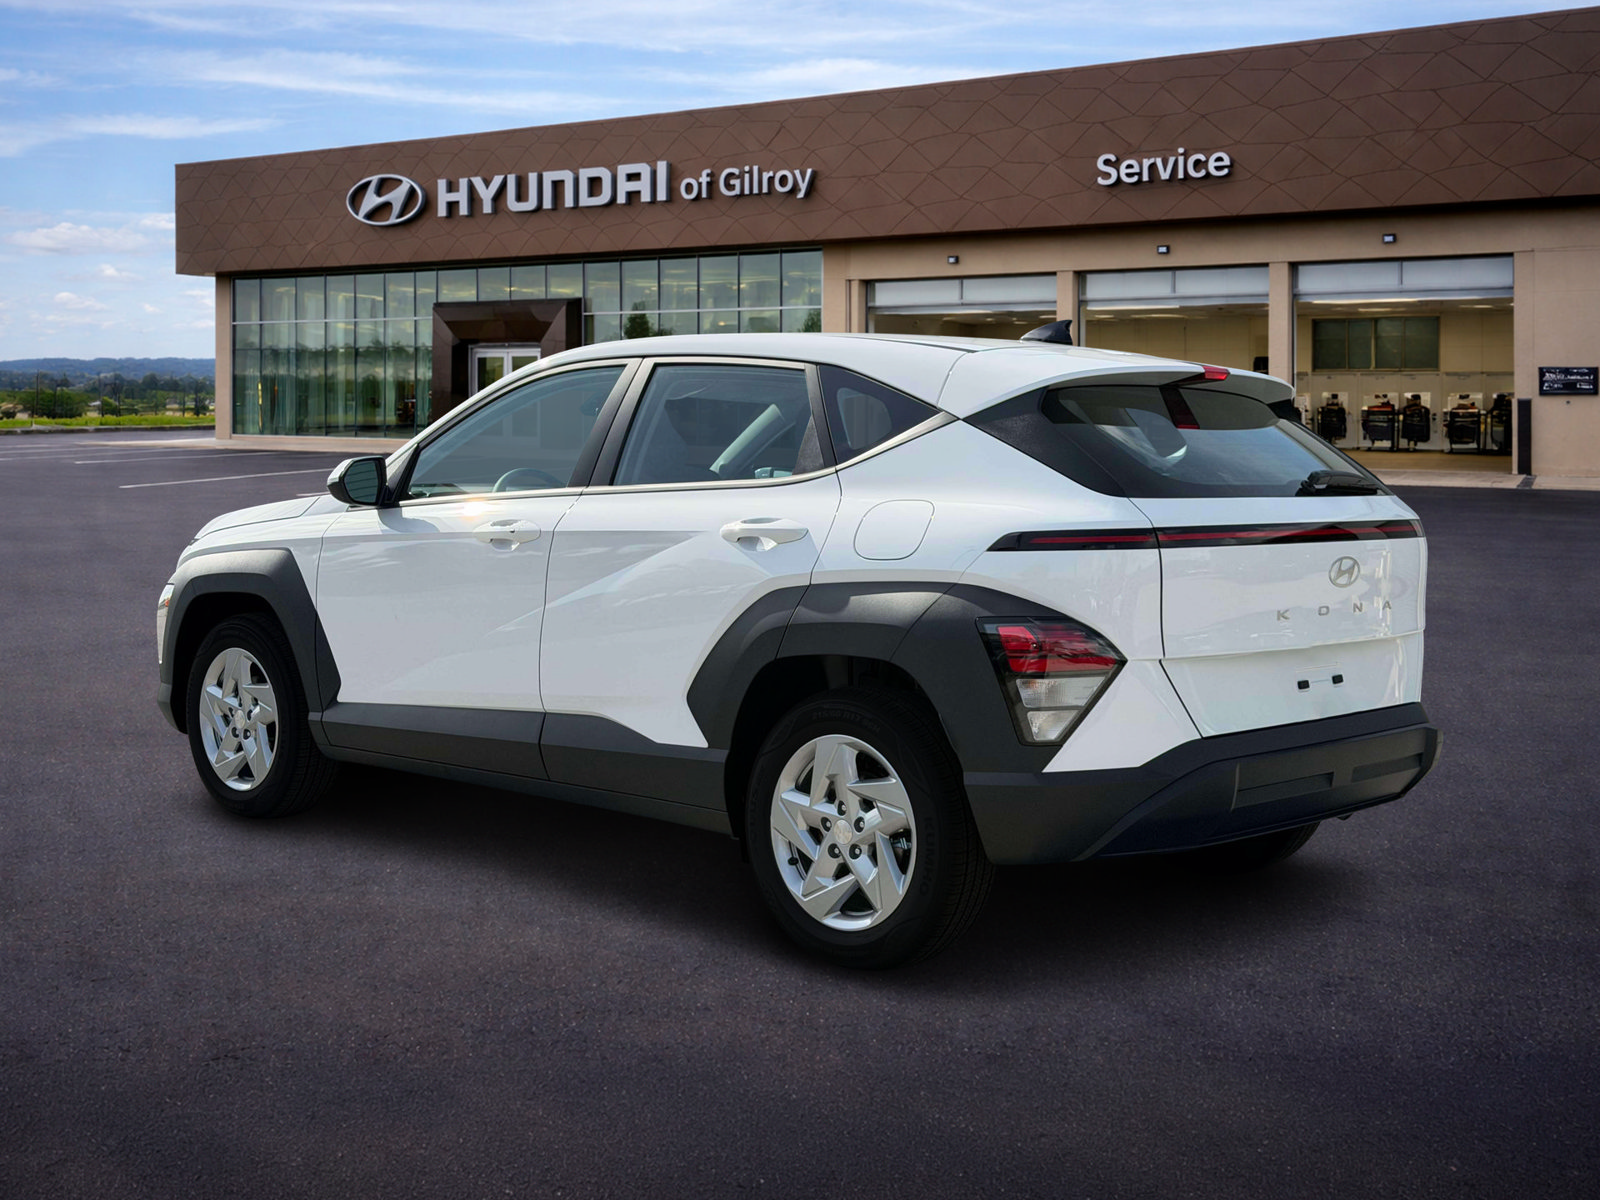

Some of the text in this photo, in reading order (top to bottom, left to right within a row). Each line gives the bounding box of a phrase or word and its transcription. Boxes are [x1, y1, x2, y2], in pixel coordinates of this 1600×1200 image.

[437, 160, 813, 217] HYUNDAI of Gilroy
[1096, 147, 1231, 186] Service
[1276, 600, 1392, 621] KONA
[919, 816, 935, 897] KUMHO
